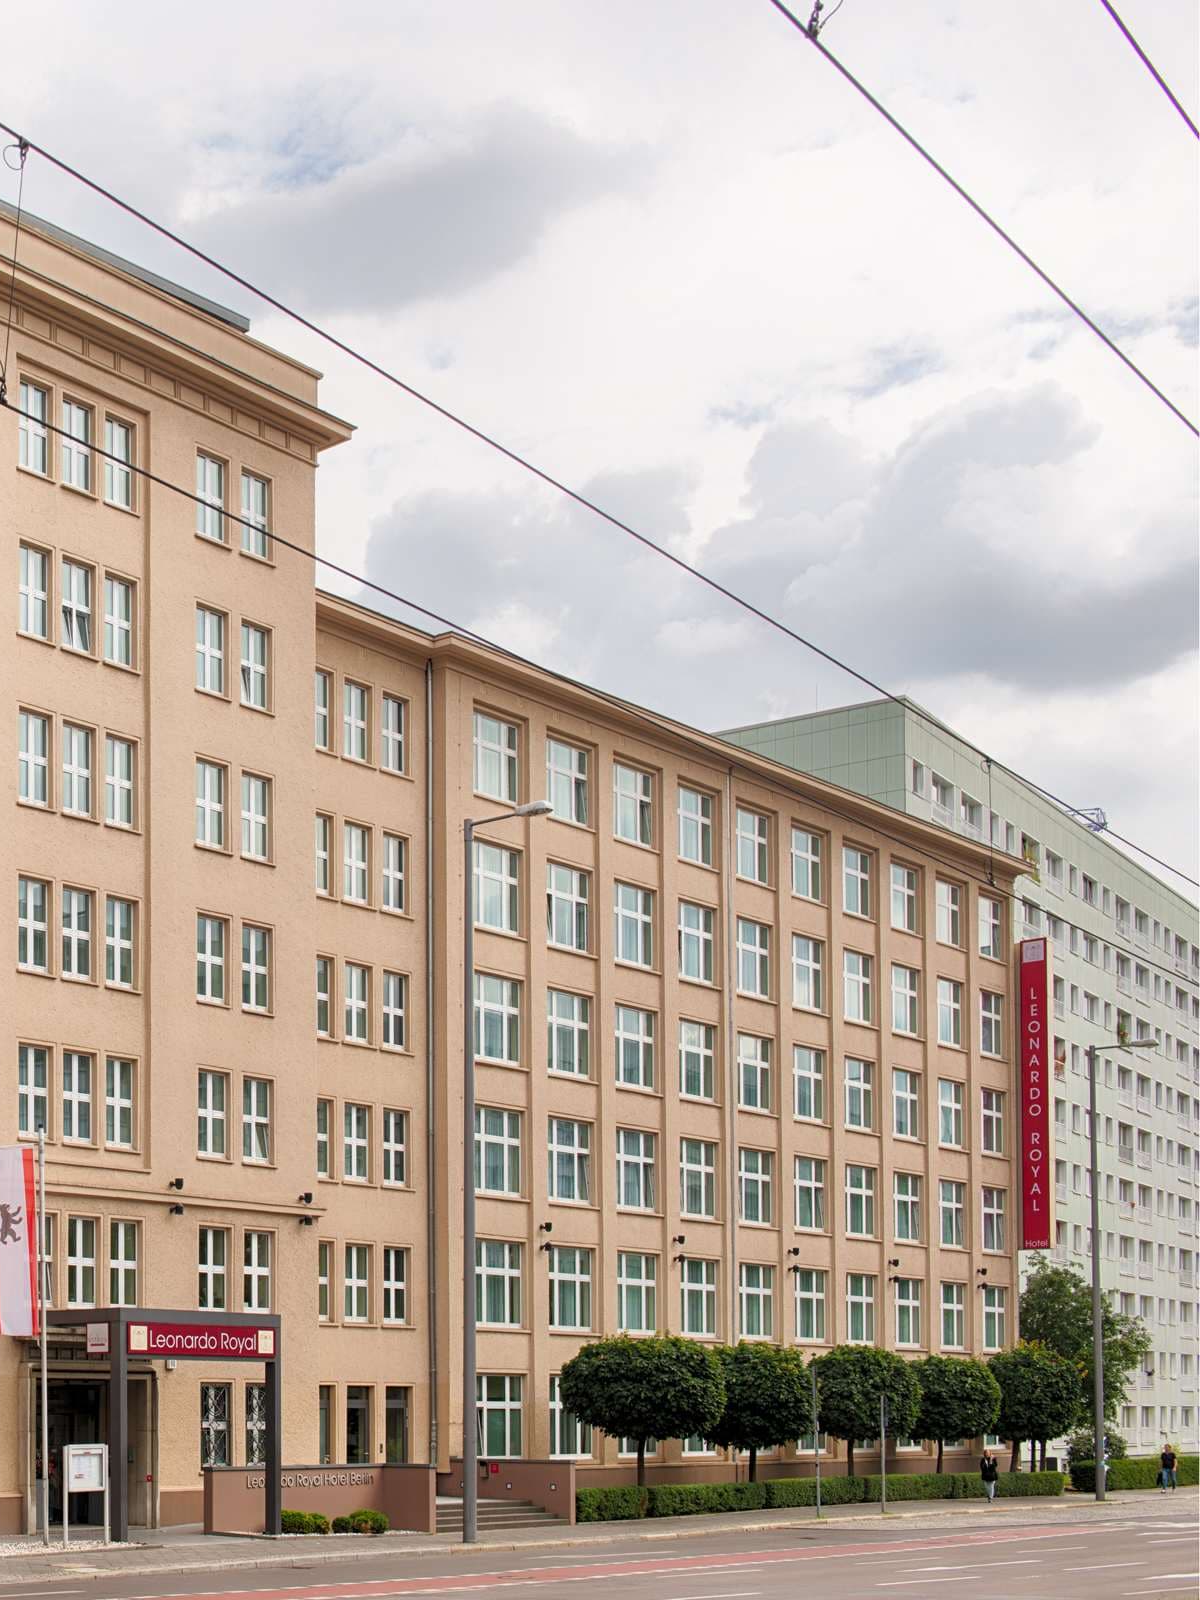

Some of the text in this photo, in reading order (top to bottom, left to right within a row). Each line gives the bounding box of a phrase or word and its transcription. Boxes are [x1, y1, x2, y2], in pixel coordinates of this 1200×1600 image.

[1027, 986, 1042, 1212] LEONARDO ROYAL
[1025, 1239, 1049, 1248] Hotel
[149, 1329, 257, 1354] Leonardo Royal
[246, 1471, 374, 1489] Leodo Royal Hotel Berlin
